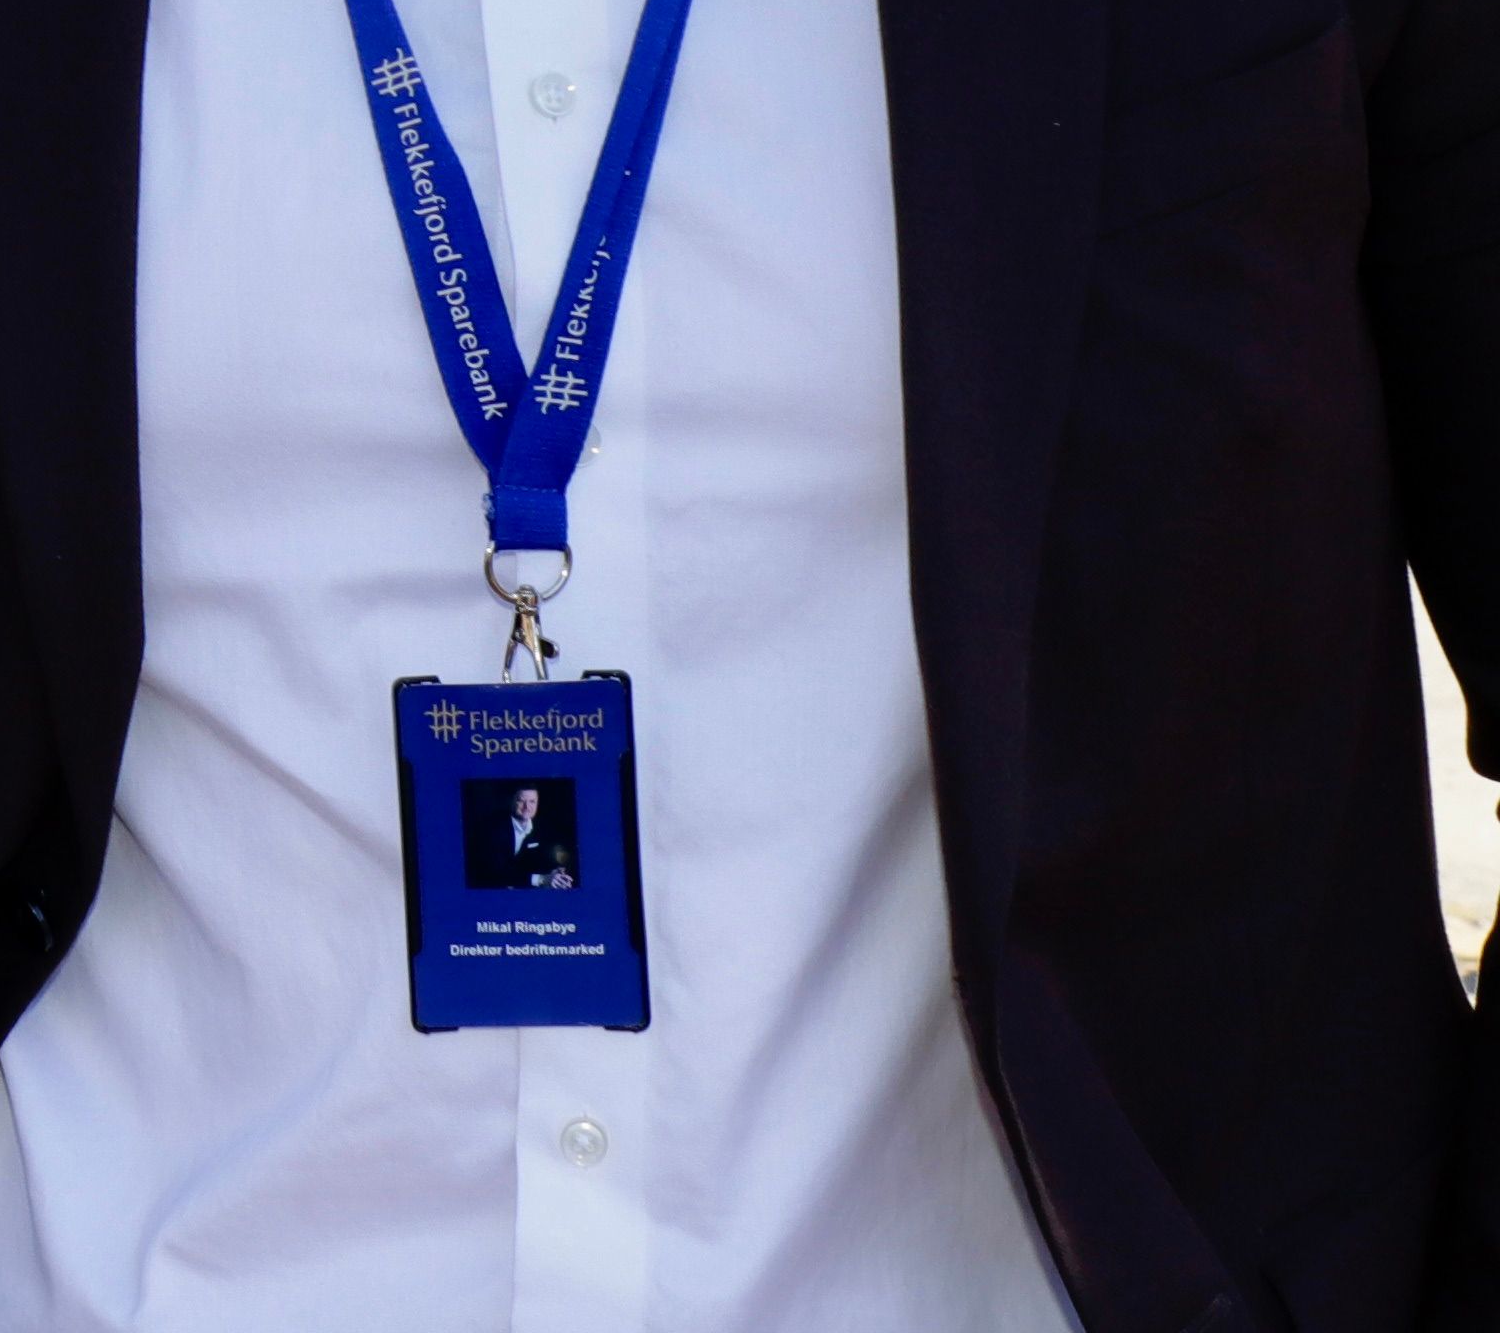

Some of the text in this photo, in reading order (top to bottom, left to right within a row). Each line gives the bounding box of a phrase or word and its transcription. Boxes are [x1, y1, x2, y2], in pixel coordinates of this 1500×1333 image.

[393, 101, 508, 421] Flekkefjord Sparebank
[469, 708, 603, 734] Flekkefjord
[471, 731, 597, 759] Sparebank
[476, 921, 511, 933] Mikal
[505, 943, 605, 956] bedriftsmarked
